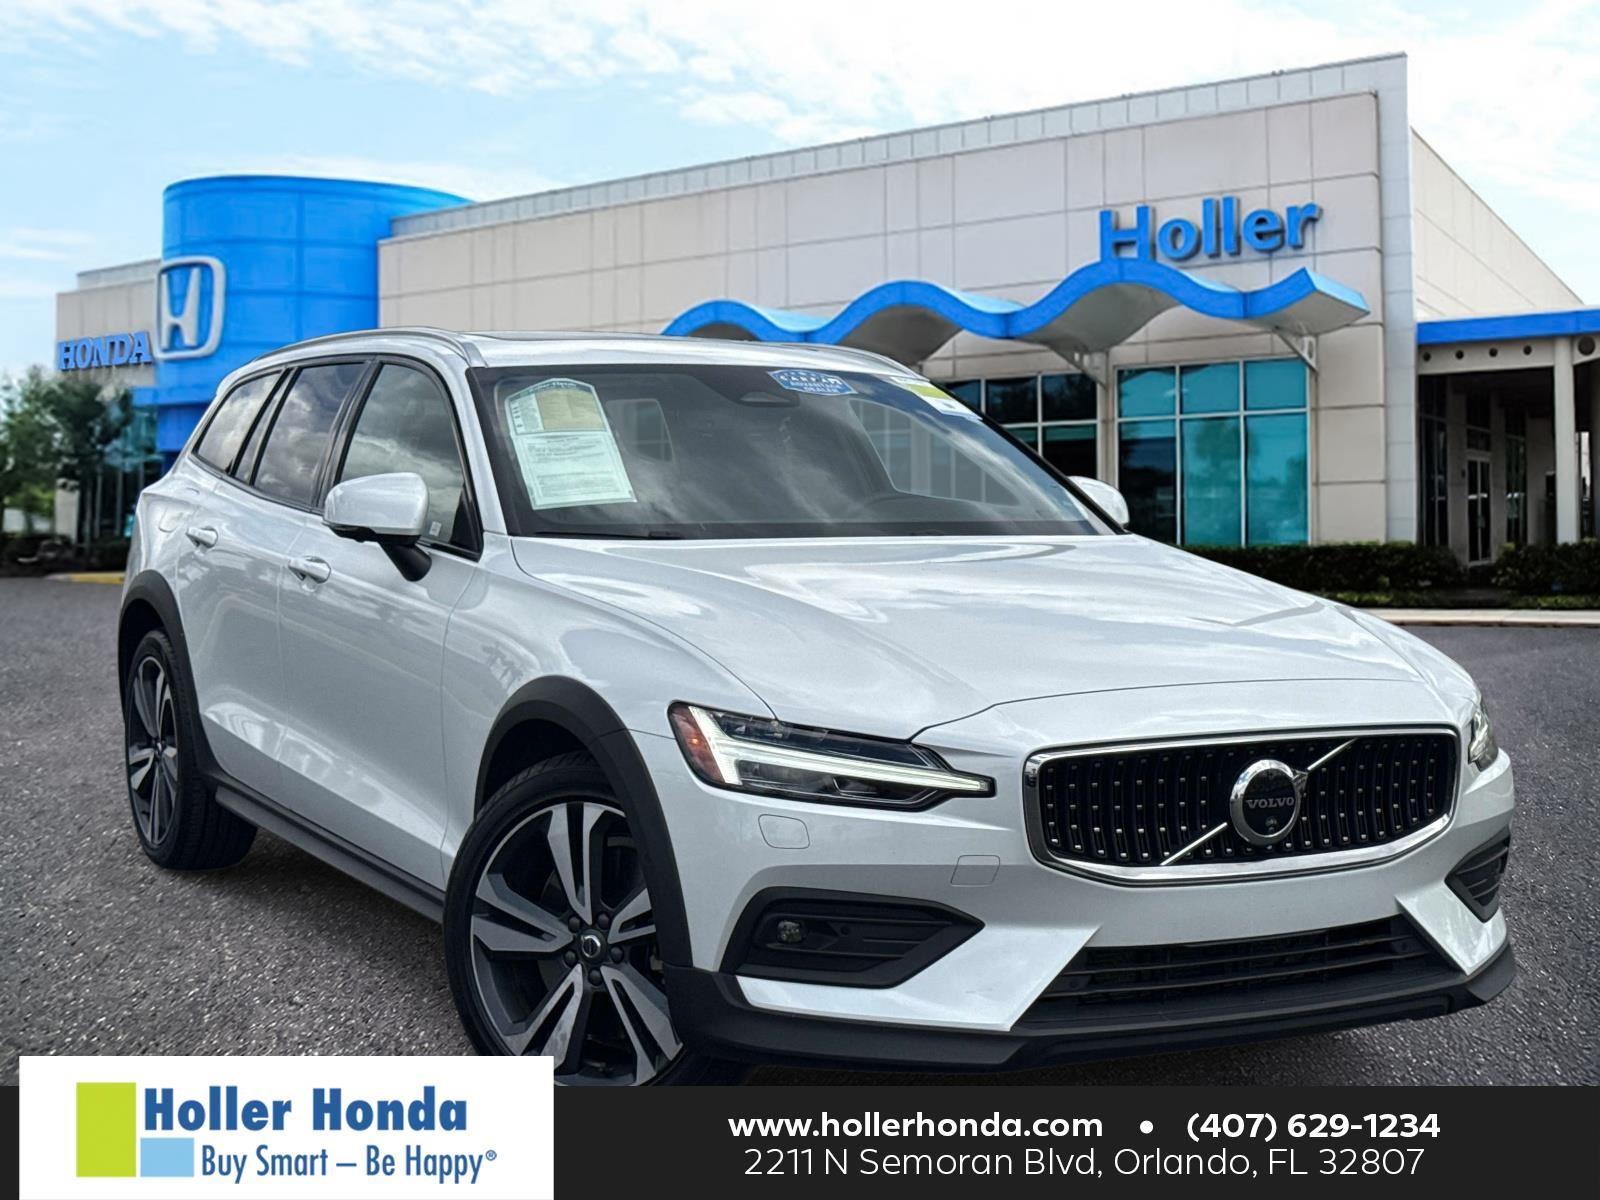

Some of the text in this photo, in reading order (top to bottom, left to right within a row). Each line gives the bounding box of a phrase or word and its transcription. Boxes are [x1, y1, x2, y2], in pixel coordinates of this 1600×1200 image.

[1099, 195, 1322, 262] Holler
[57, 331, 153, 371] HONDA
[1245, 796, 1295, 809] VOLVO
